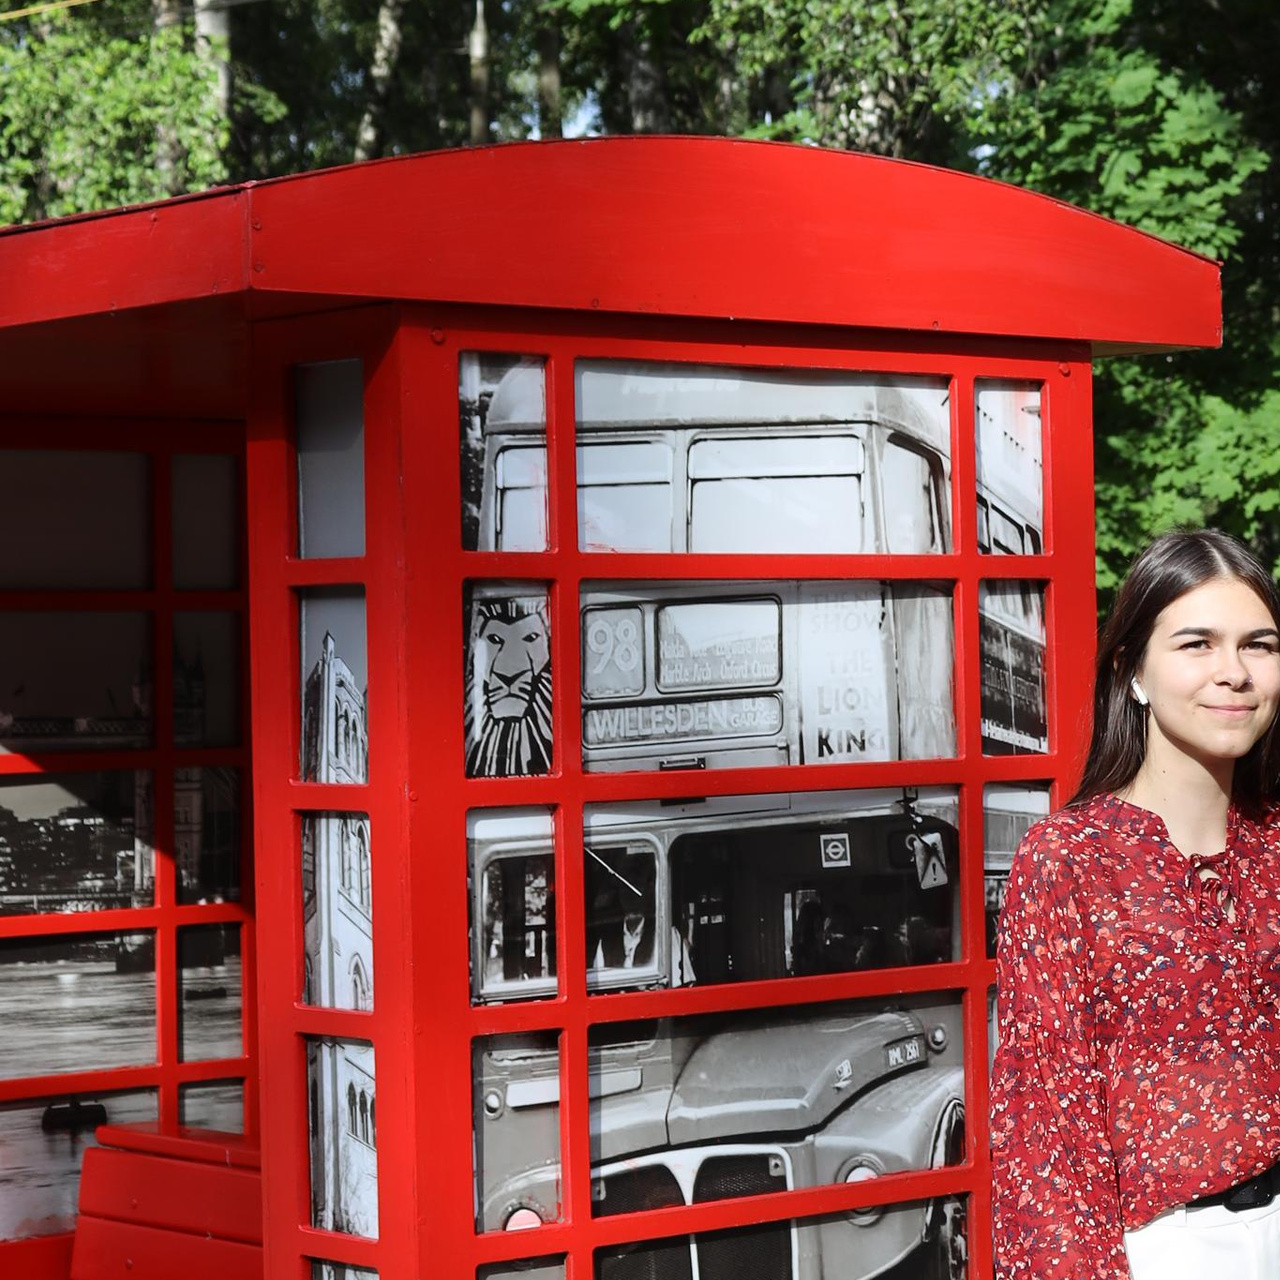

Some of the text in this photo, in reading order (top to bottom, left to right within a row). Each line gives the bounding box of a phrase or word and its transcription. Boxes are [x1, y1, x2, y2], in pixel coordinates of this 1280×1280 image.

[587, 620, 638, 675] 98
[817, 686, 882, 715] LION
[592, 700, 729, 739] WILLESDEN
[730, 711, 778, 728] GARAGE
[817, 726, 886, 758] KING
